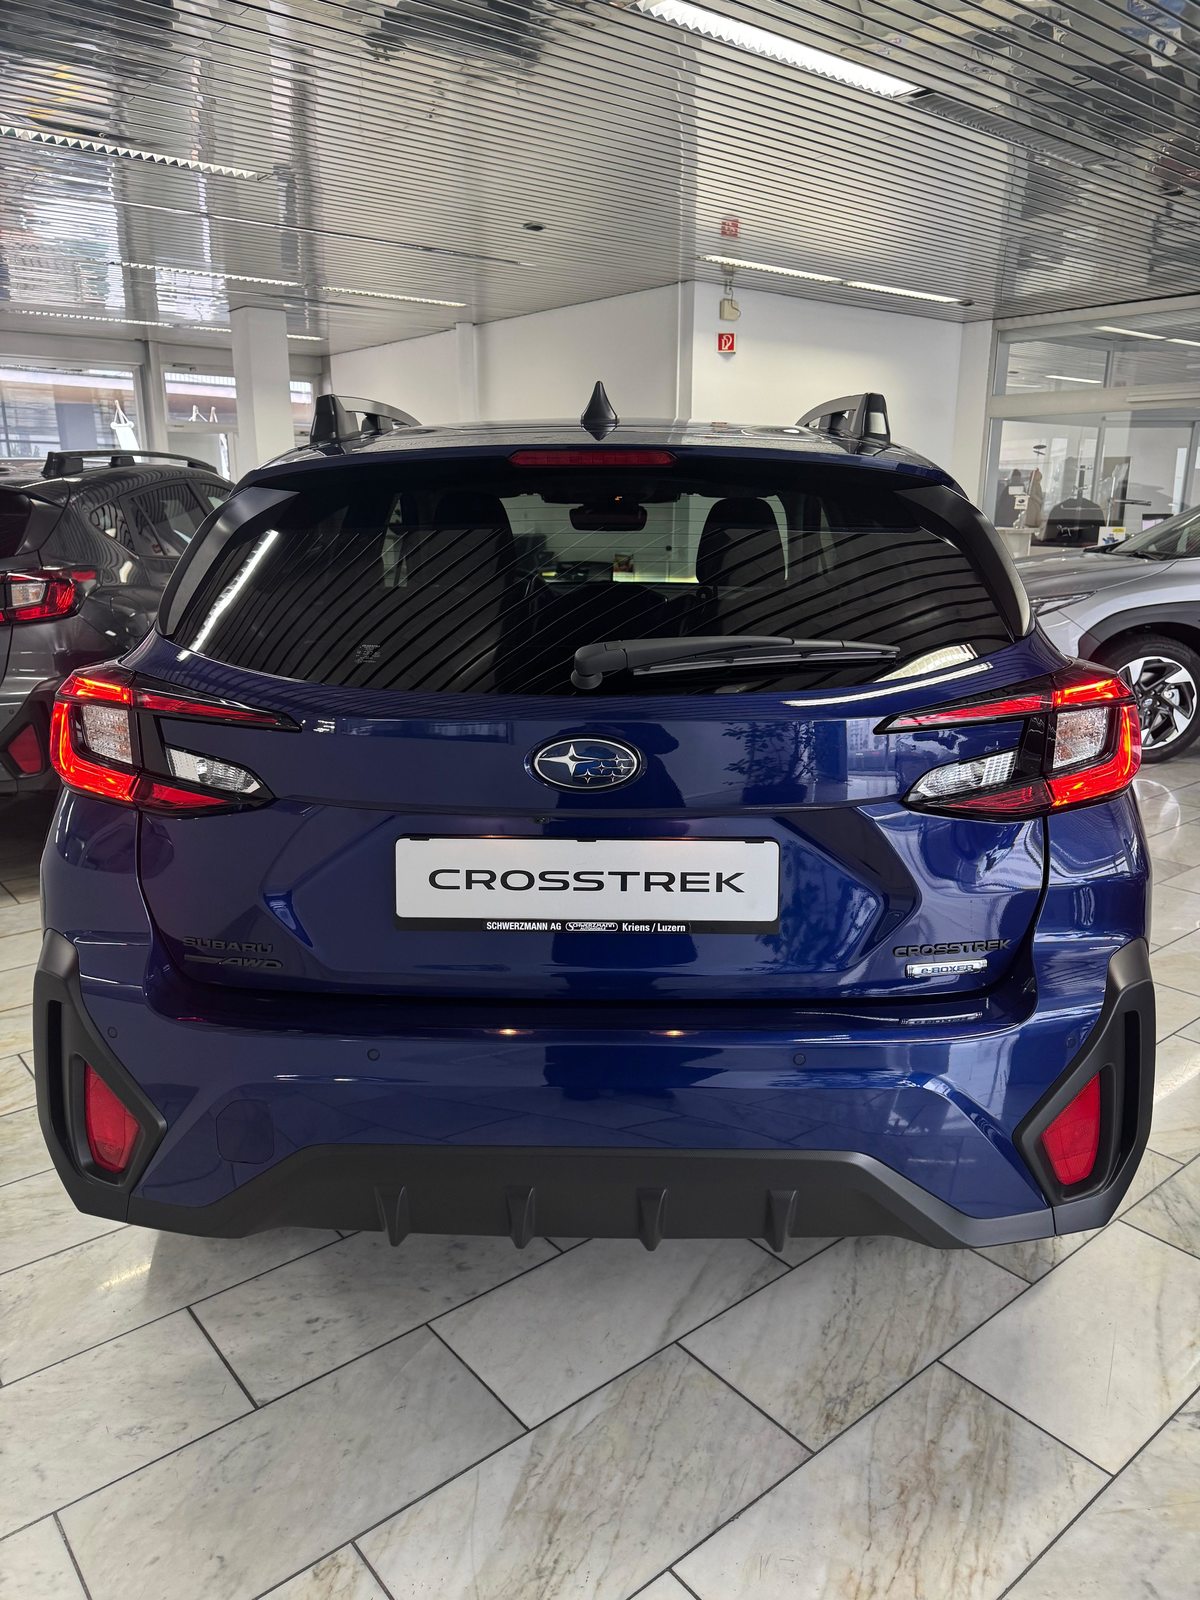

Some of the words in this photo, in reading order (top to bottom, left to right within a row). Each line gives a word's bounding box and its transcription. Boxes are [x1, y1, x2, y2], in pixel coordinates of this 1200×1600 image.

[428, 868, 745, 893] CROSSTREK
[486, 921, 548, 931] SCHWERZMANN
[550, 922, 562, 931] AG
[622, 922, 650, 932] Kriens
[657, 923, 686, 932] Luzern
[183, 936, 273, 953] SUBARU
[893, 939, 1011, 957] CROSSTREK
[222, 957, 283, 969] AWD
[921, 964, 974, 974] e-BOXER
